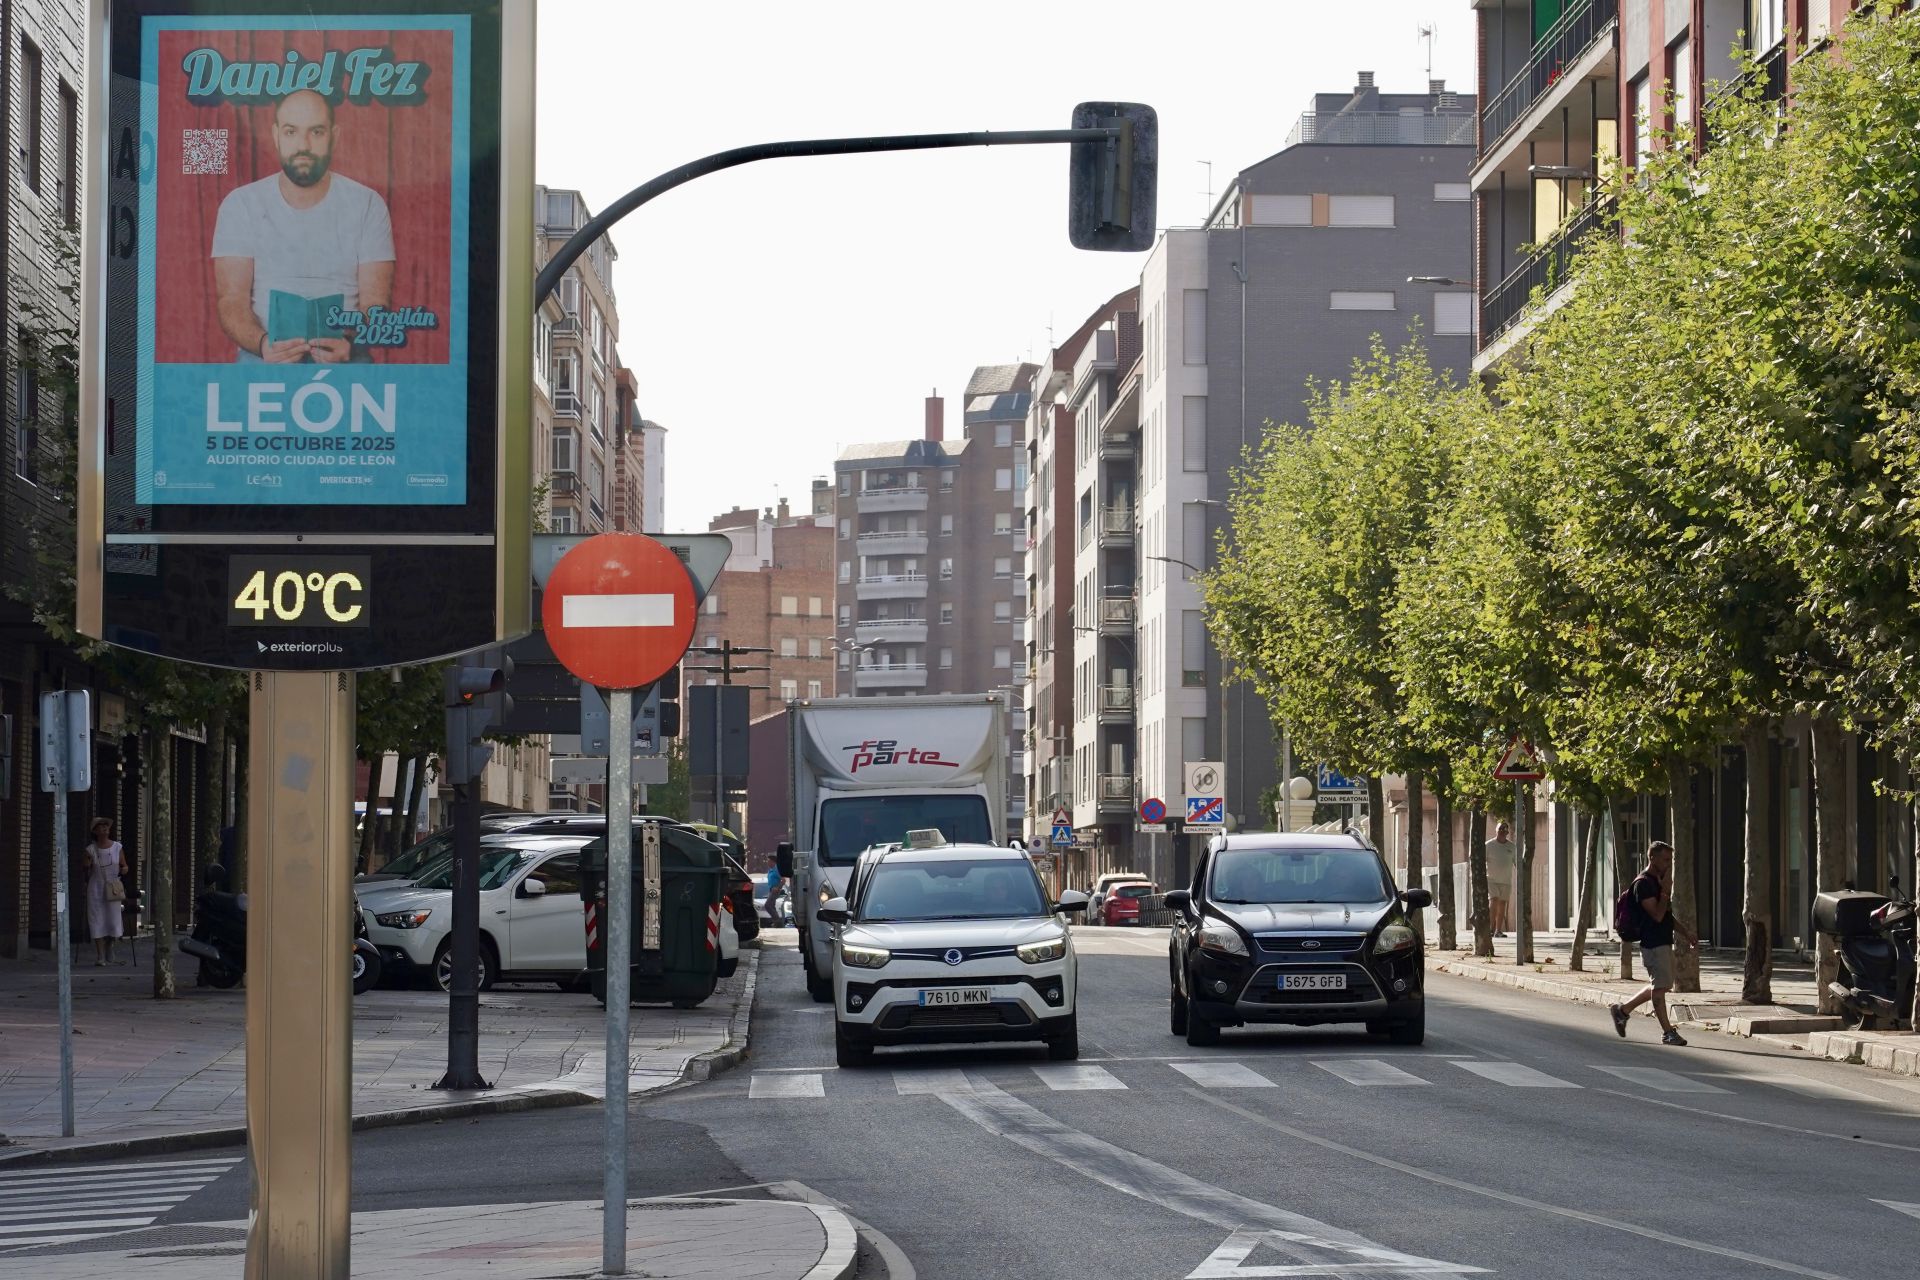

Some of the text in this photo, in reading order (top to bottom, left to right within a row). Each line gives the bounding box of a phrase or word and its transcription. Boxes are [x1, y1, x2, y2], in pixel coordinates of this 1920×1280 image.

[183, 48, 420, 96] Daniel Fez
[326, 304, 436, 327] San Froilán
[353, 325, 406, 345] 2025
[206, 369, 397, 434] LEÓN
[206, 436, 396, 451] 5 DE OCTUBRE 2025
[206, 453, 396, 465] AUDITORIO CIUDAD DE LEÓN
[234, 570, 363, 622] 40°C
[270, 642, 343, 654] exteriorplus
[851, 747, 960, 774] parte
[1196, 773, 1214, 786] 10
[1286, 976, 1343, 988] 5675 GFB
[927, 989, 988, 1004] 7610 MKN
